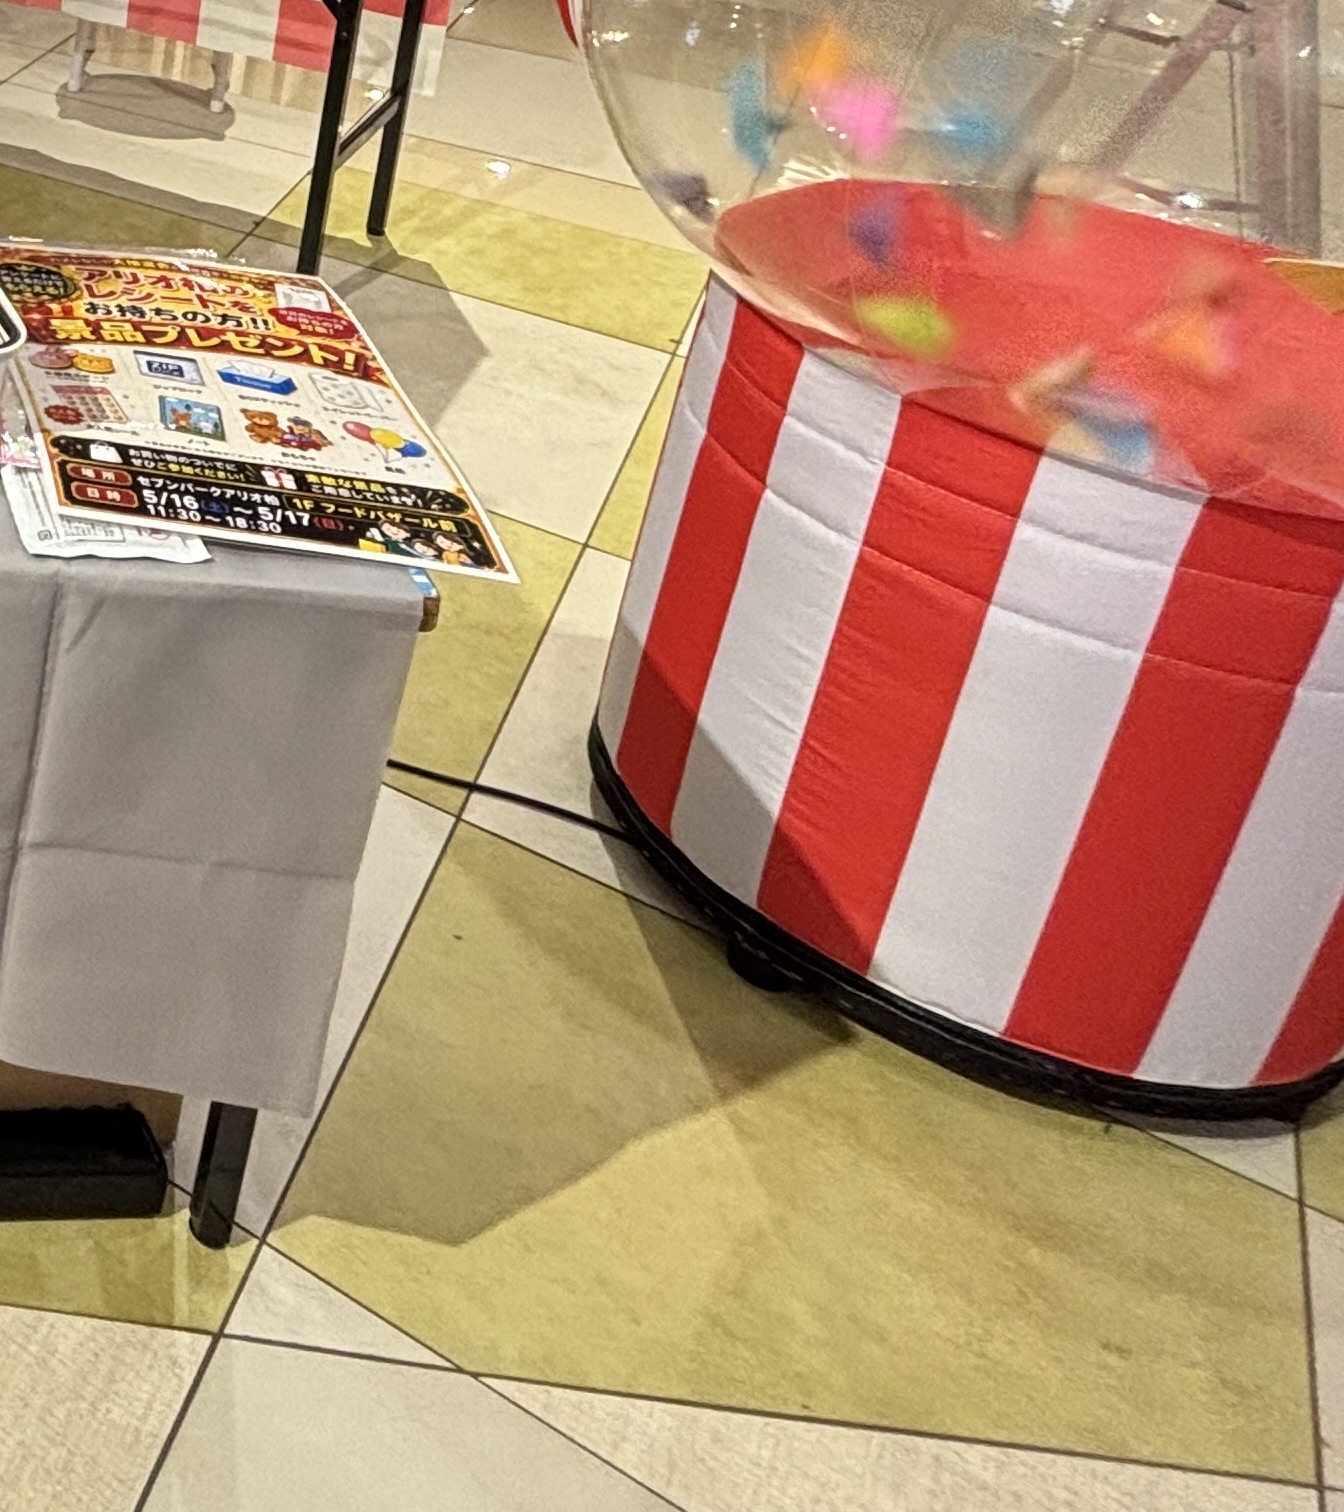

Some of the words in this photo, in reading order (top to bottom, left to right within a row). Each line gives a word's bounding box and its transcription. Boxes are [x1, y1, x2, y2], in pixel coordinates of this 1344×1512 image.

[83, 284, 258, 313] レシートを
[48, 318, 356, 370] 景品プレゼント!
[291, 497, 315, 510] 1F
